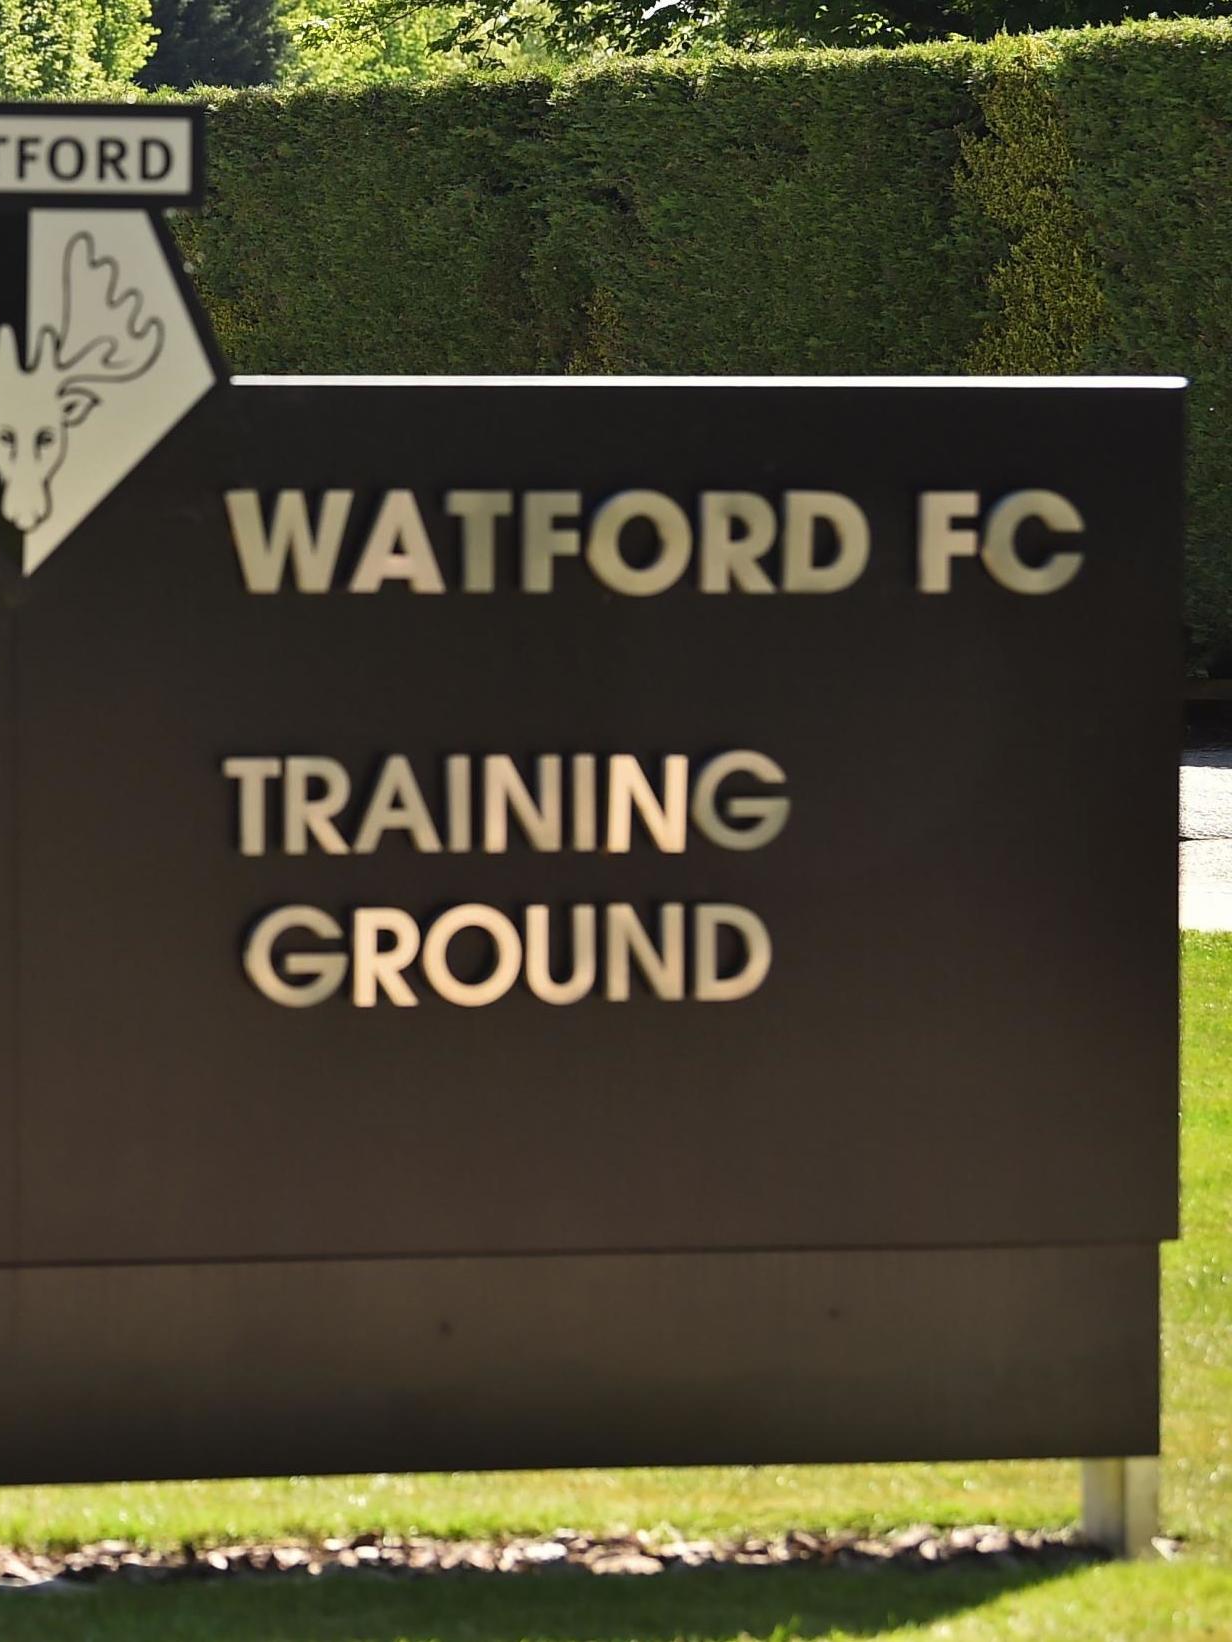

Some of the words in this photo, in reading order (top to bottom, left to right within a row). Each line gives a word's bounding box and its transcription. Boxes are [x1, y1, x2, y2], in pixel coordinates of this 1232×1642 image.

[224, 488, 872, 597] WATFORD
[918, 488, 1086, 597] FC
[221, 749, 792, 857] TRAINING
[243, 903, 774, 1010] GROUND
